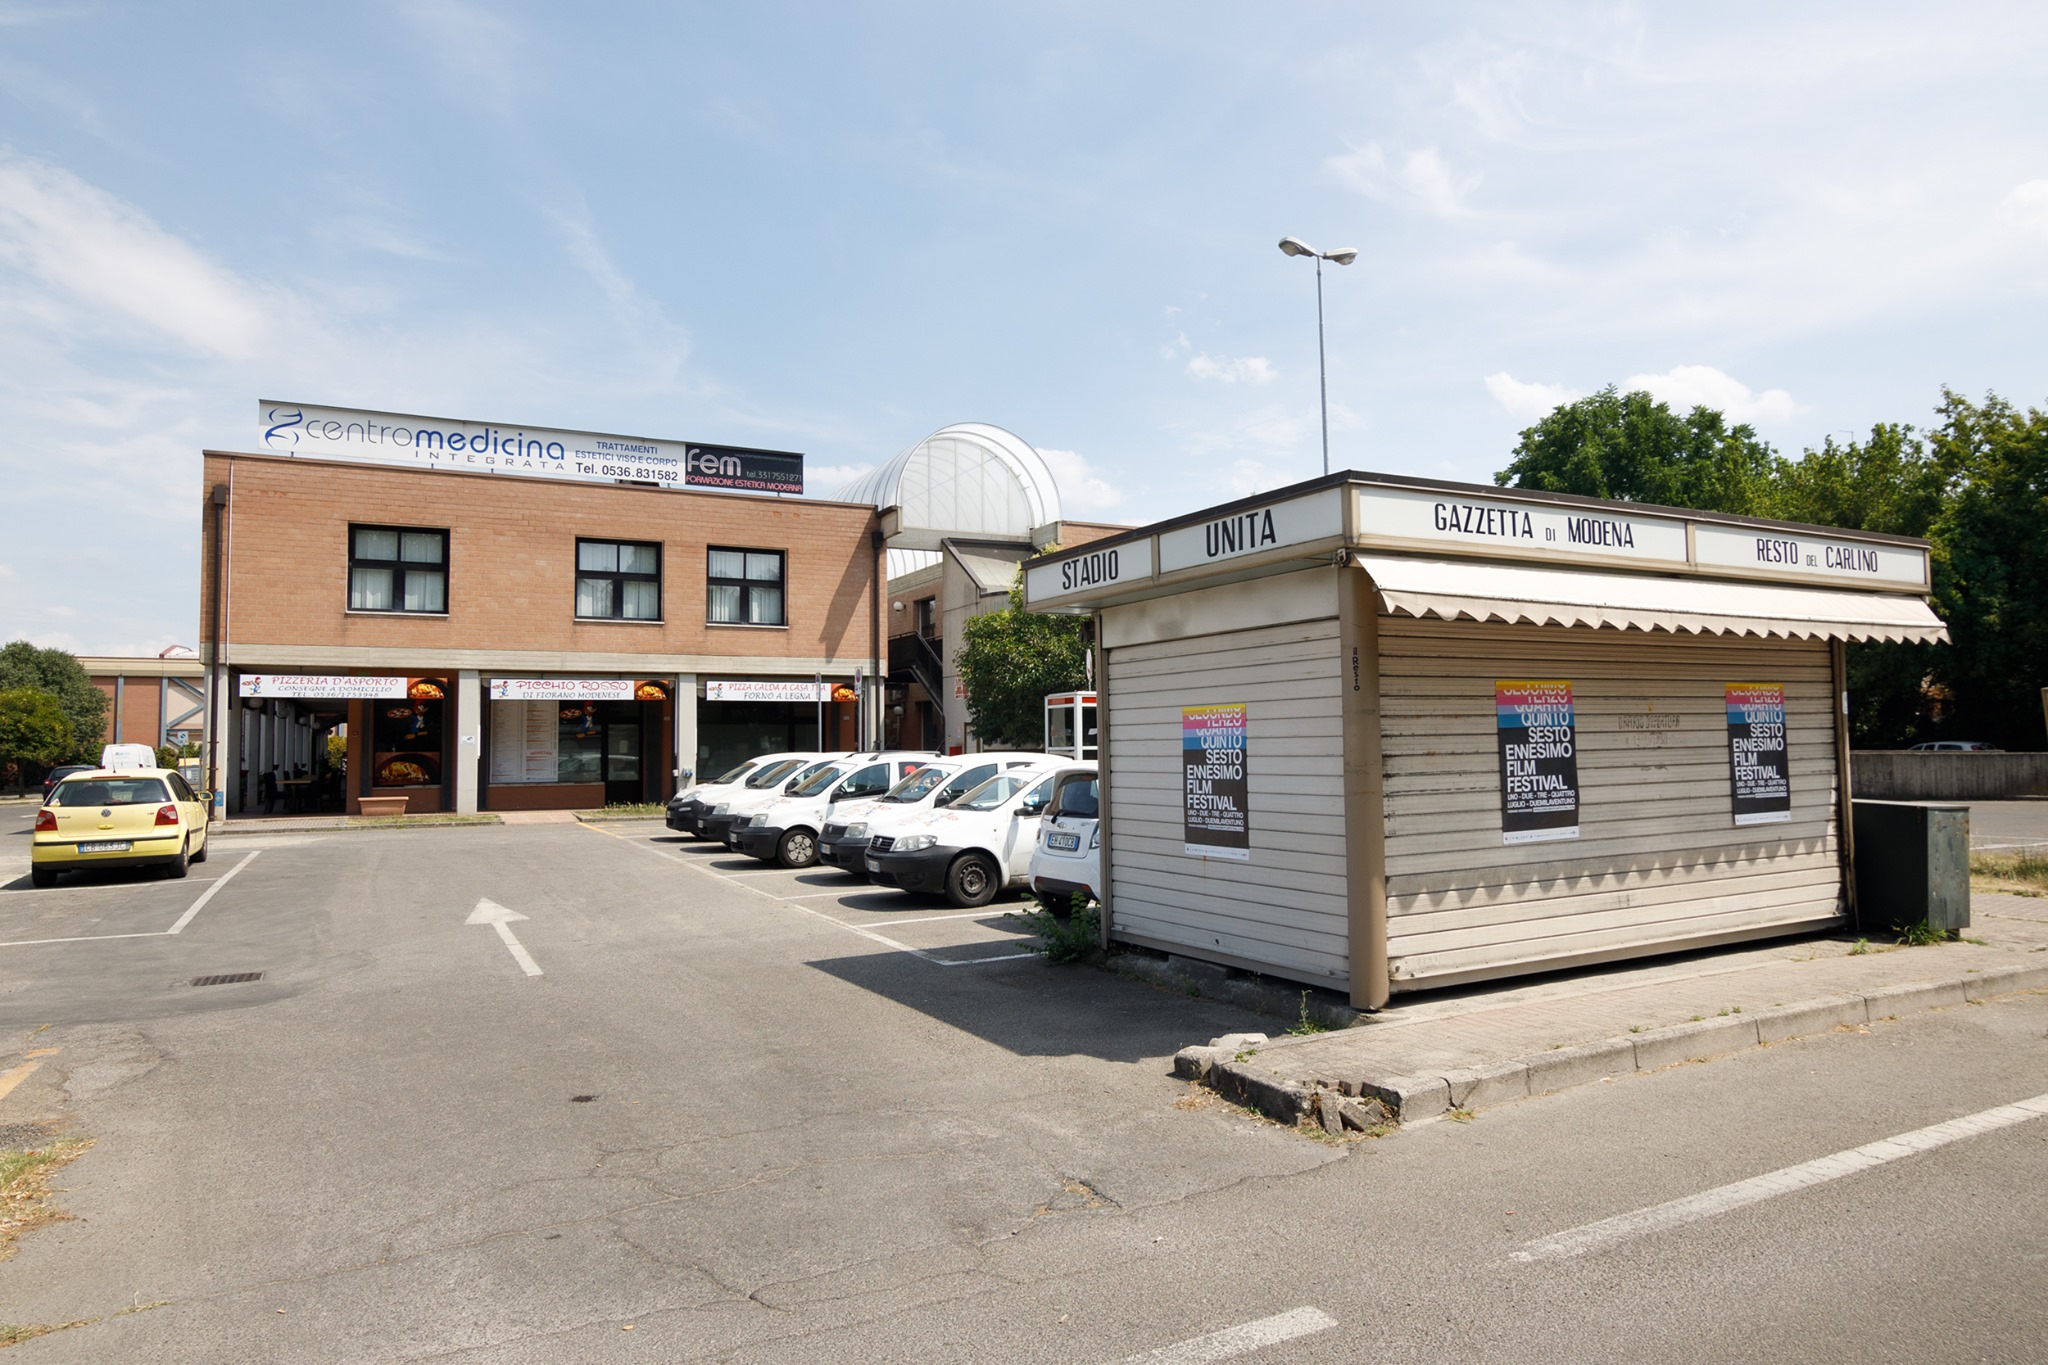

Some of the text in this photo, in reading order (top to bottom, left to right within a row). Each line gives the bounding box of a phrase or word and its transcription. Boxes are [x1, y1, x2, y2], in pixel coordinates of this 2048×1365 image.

[306, 419, 565, 460] centromedicina
[596, 441, 658, 454] TRATTAMENTI
[415, 450, 565, 469] INTEGRATA
[575, 451, 678, 467] ESTETICI VISO E CORPO
[575, 462, 678, 481] Tel. 0536.831582
[1206, 508, 1277, 558] UNITA
[1434, 503, 1634, 549] GAZZETTA DI MODENA
[1756, 538, 1878, 573] RESTO DEL CARLINO
[1062, 550, 1119, 590] STADIO
[272, 676, 398, 686] PIZZERIA D'ASPORTO
[516, 681, 628, 691] PICCHIO ROSSO
[728, 683, 751, 691] PIZZA
[754, 683, 779, 692] CALDA
[789, 683, 808, 692] CASA
[744, 692, 811, 700] FORNO A LEGNA
[1521, 713, 1569, 726] QUINTO
[1745, 711, 1782, 723] QUINTO
[1528, 726, 1570, 743] SESTO
[1750, 723, 1783, 737] SESTO
[1201, 736, 1242, 748] QUINTO
[1733, 738, 1784, 752] ENNESIMO
[1206, 749, 1242, 765] SESTO
[1505, 742, 1572, 760] ENNESIMO
[1734, 752, 1757, 766] FILM
[1187, 764, 1242, 780] ENNESIMO
[1506, 760, 1536, 776] FILM
[1735, 766, 1780, 780] FESTIVAL
[1187, 780, 1212, 794] FILM
[1507, 774, 1567, 793] FESTIVAL
[1187, 795, 1237, 811] FESTIVAL
